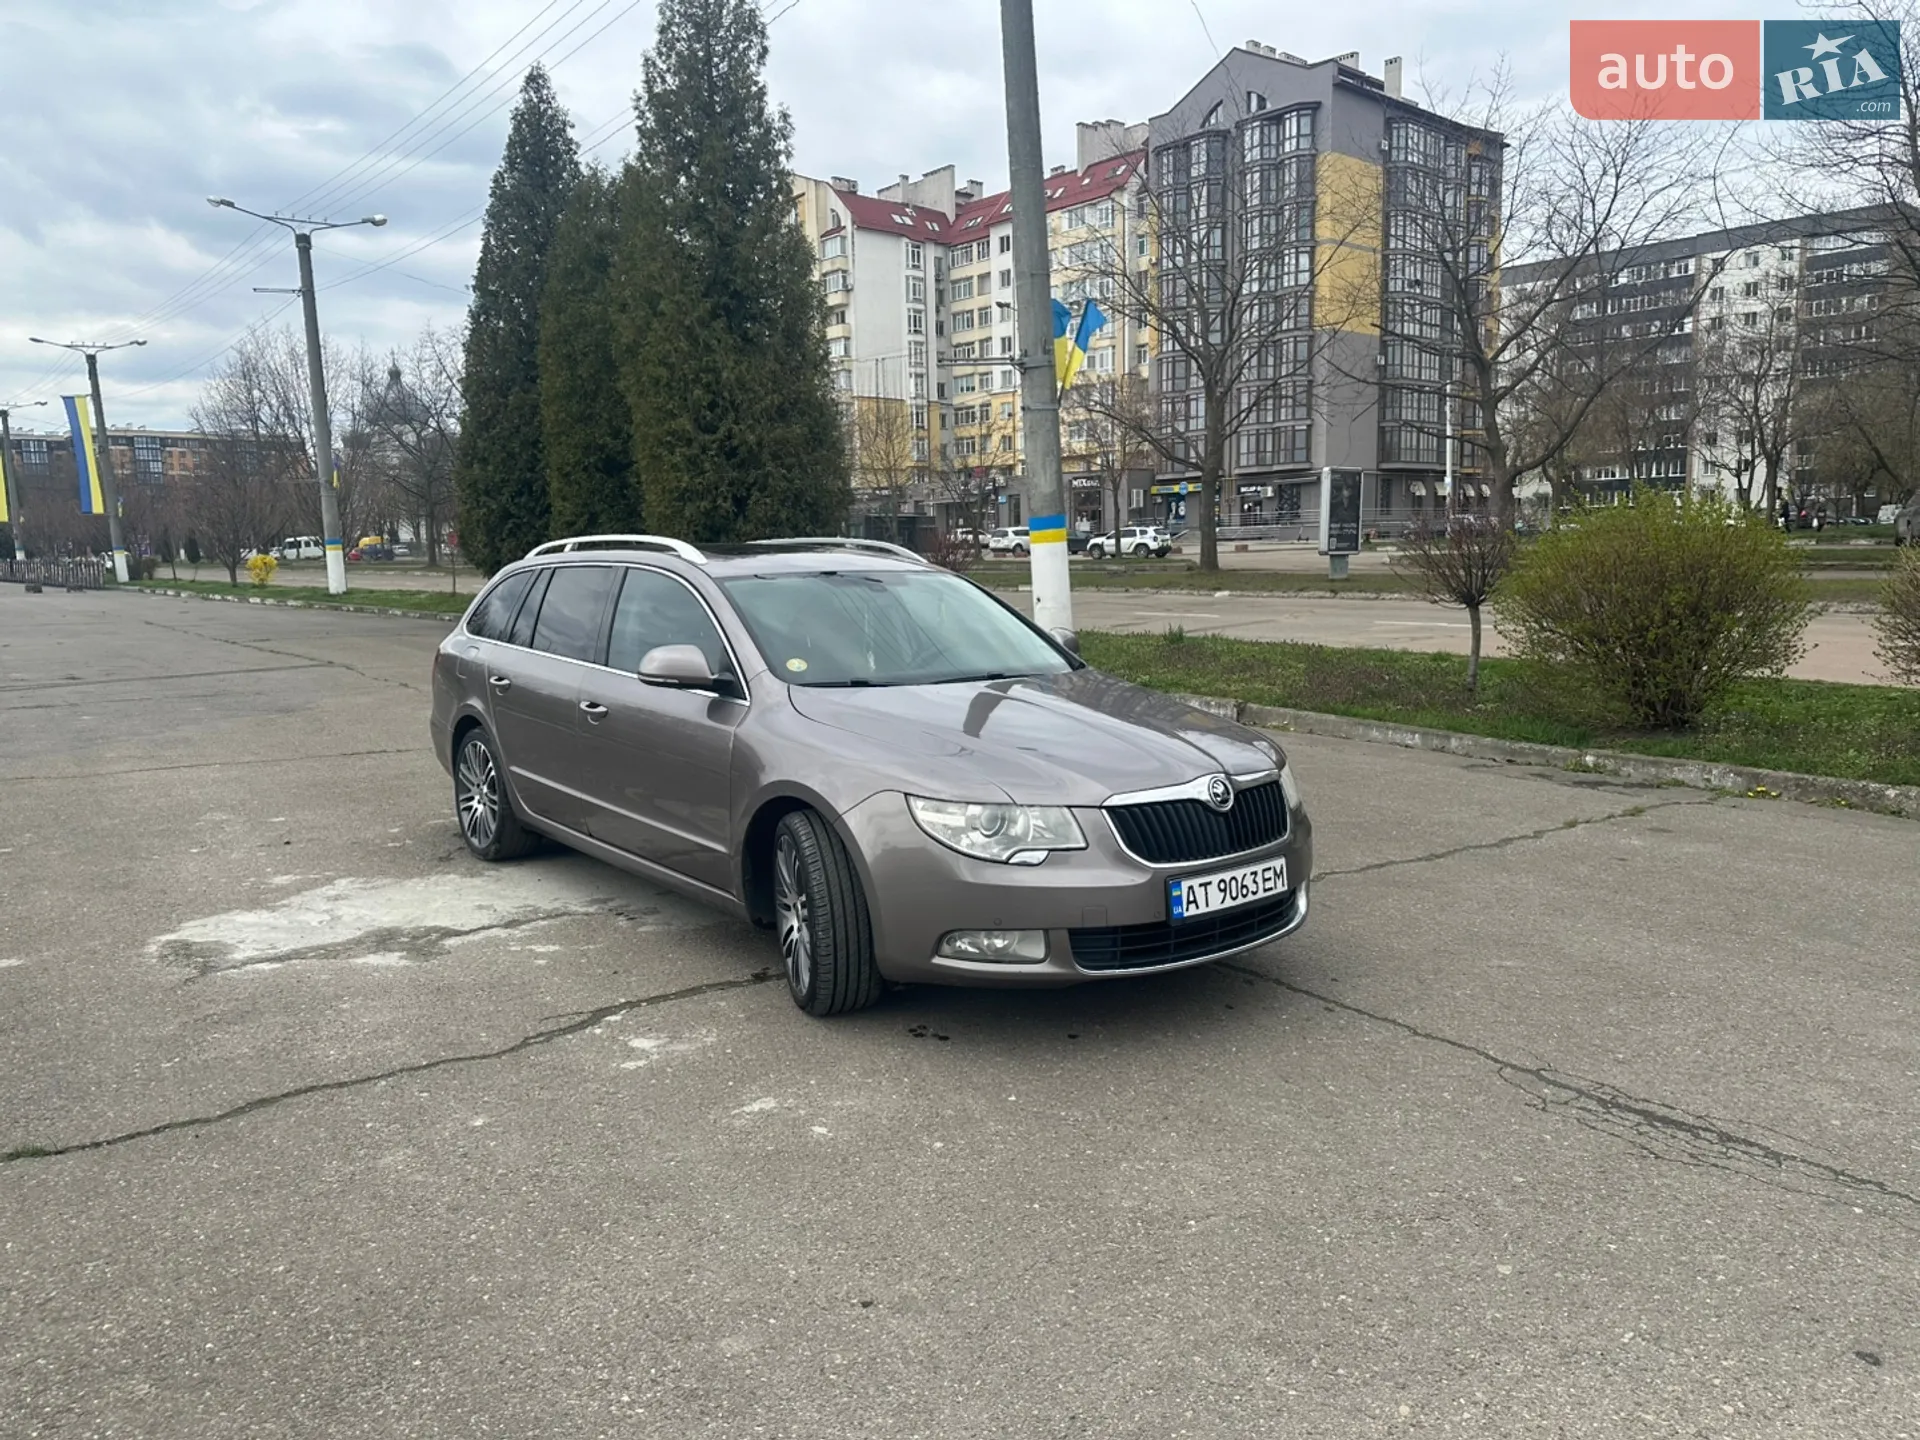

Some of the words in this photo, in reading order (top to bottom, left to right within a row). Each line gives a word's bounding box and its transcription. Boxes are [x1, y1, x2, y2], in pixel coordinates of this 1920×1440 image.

[1185, 881, 1212, 912] AT
[1217, 871, 1259, 904] 9063
[1261, 864, 1286, 893] EM
[1173, 905, 1183, 914] UA
